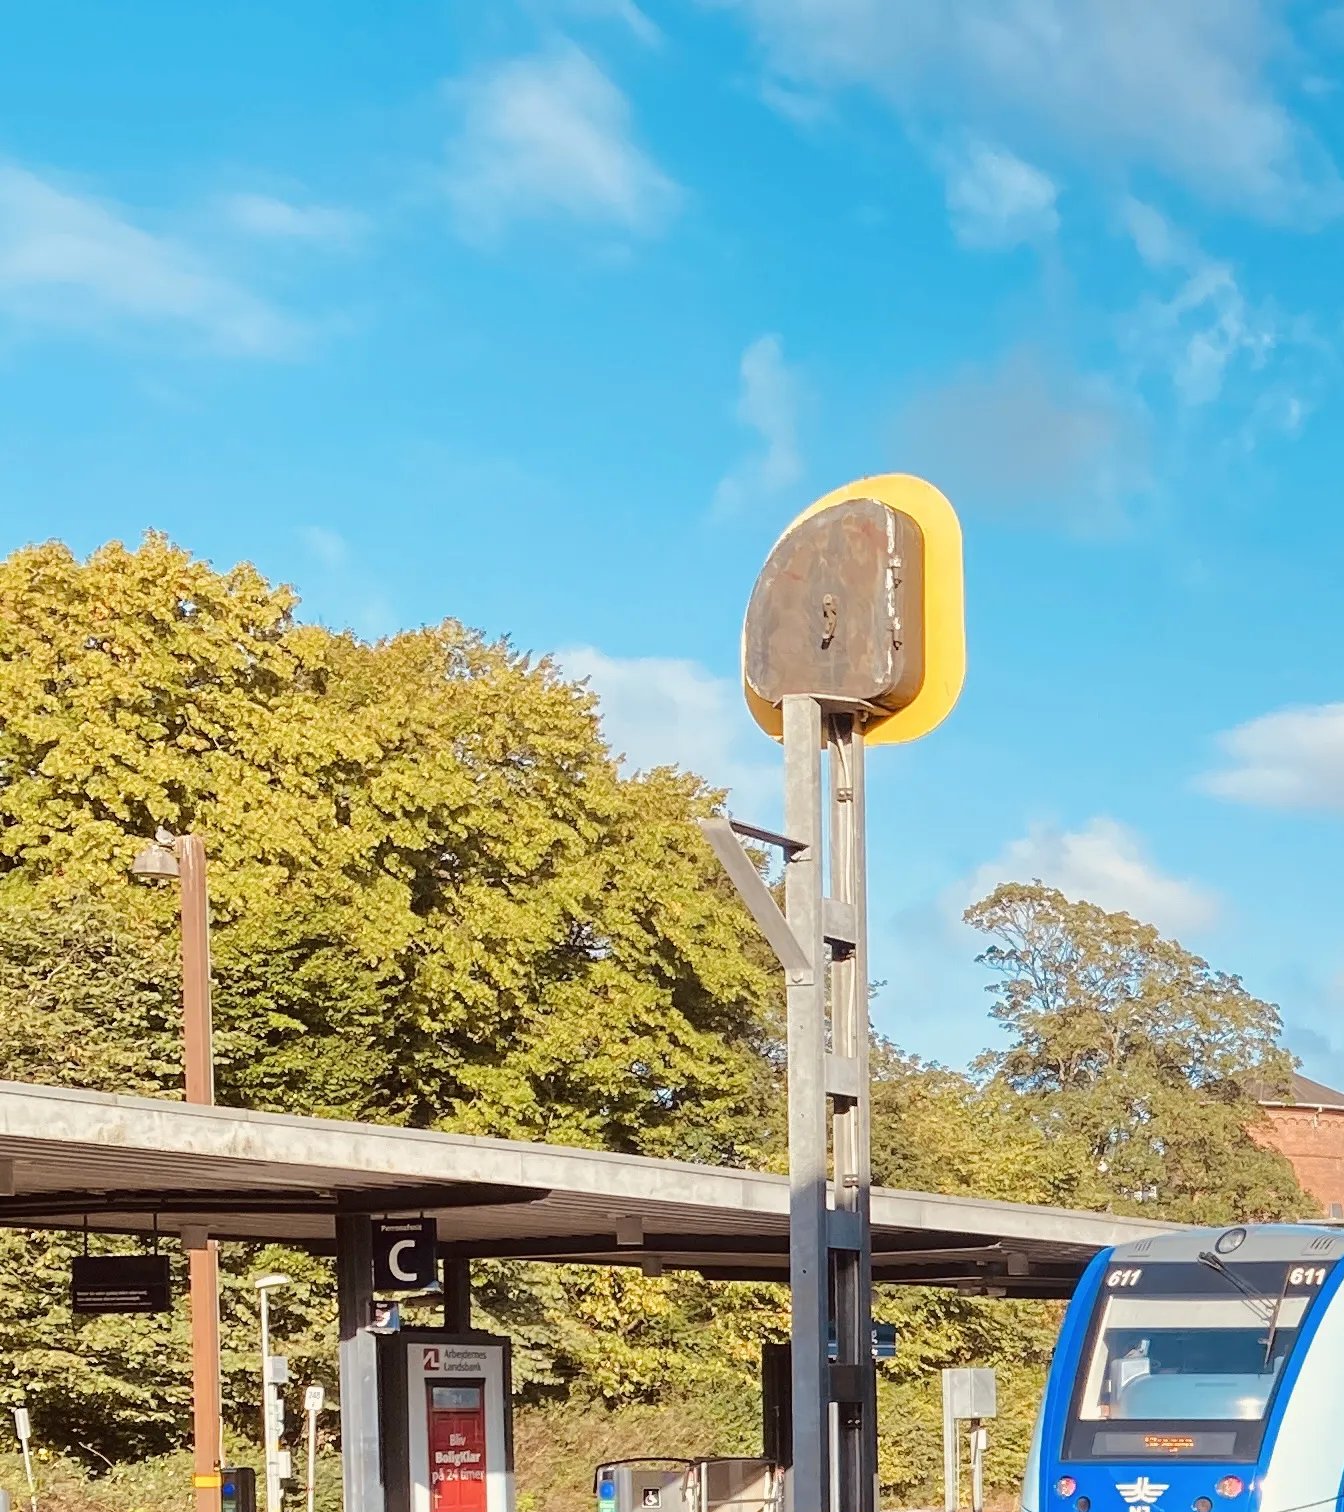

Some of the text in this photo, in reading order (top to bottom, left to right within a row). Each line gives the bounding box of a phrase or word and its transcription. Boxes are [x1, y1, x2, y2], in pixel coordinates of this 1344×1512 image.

[388, 1239, 418, 1282] C
[1107, 1269, 1142, 1287] 611
[1290, 1267, 1327, 1285] 611
[443, 1362, 482, 1372] Landsbank
[449, 1433, 466, 1446] Bliv
[434, 1450, 481, 1467] BoligKlar
[431, 1467, 485, 1485] på 24 timer
